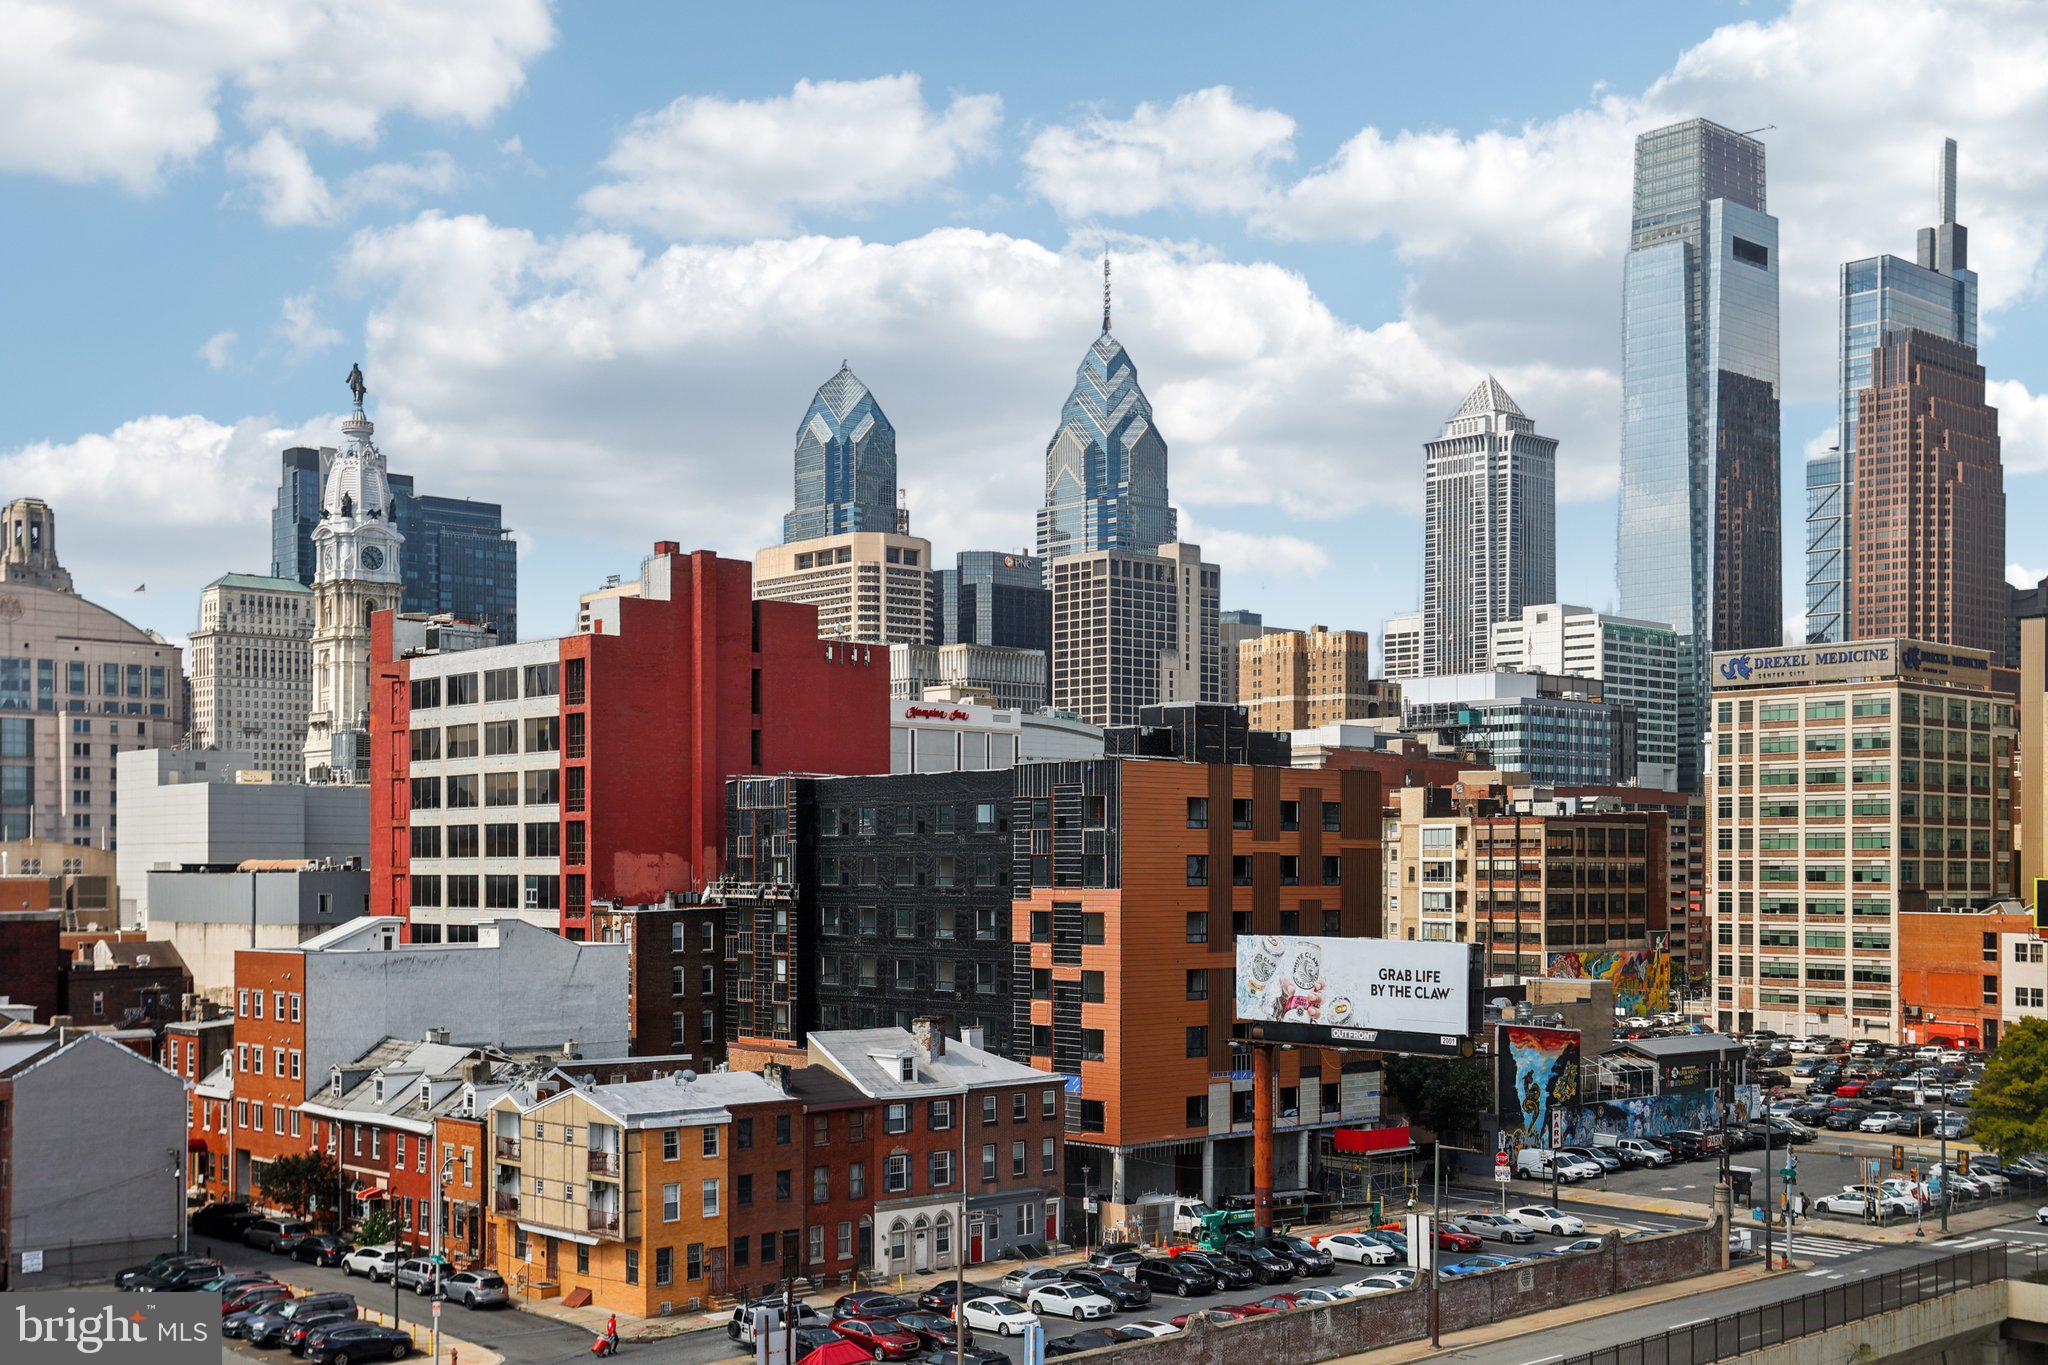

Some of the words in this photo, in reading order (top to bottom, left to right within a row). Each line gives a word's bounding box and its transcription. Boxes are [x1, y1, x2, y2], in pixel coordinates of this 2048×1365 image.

[1015, 559, 1031, 569] PNC
[1754, 654, 1809, 669] DREXEL
[1815, 649, 1889, 665] MEDICINE
[1921, 651, 1950, 665] DREXEL
[1952, 655, 1988, 670] MEDICINE
[905, 706, 947, 719] Hampton
[949, 709, 969, 720] Inn
[1379, 968, 1412, 981] GRAB
[1415, 970, 1441, 983] LIFE
[1371, 984, 1385, 996] BY
[1388, 985, 1411, 998] THE
